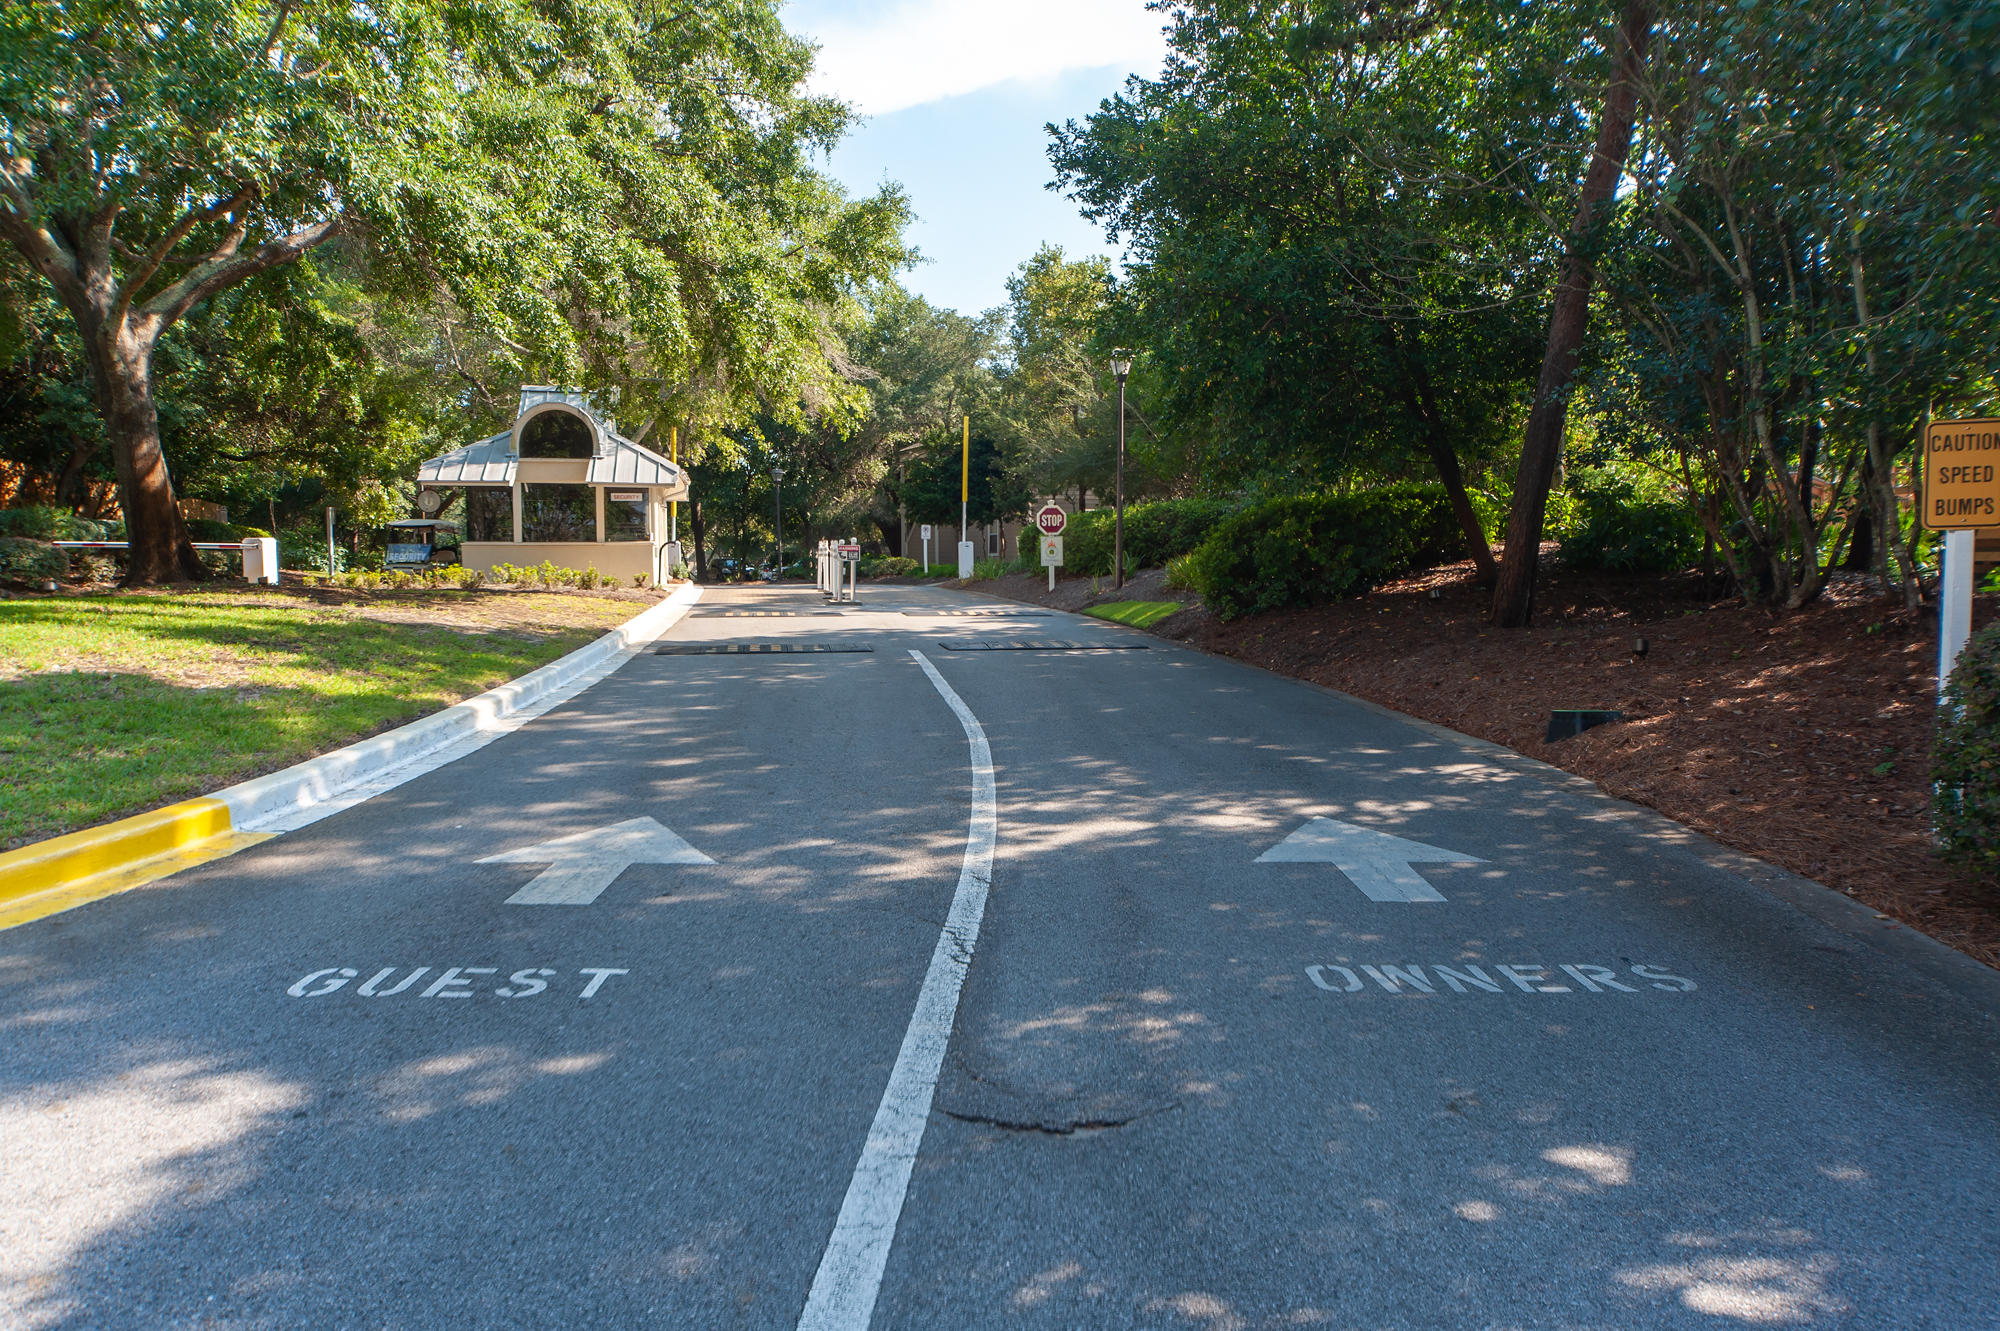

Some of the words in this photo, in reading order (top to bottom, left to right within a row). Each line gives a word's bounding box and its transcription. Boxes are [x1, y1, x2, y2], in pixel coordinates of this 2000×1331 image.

[1931, 432, 2000, 452] CAUTION
[1939, 465, 1994, 484] SPEED
[1935, 497, 1995, 516] BUMPS
[1041, 514, 1063, 527] STOP
[286, 966, 631, 999] GUEST
[1304, 964, 1698, 993] OWNERS
